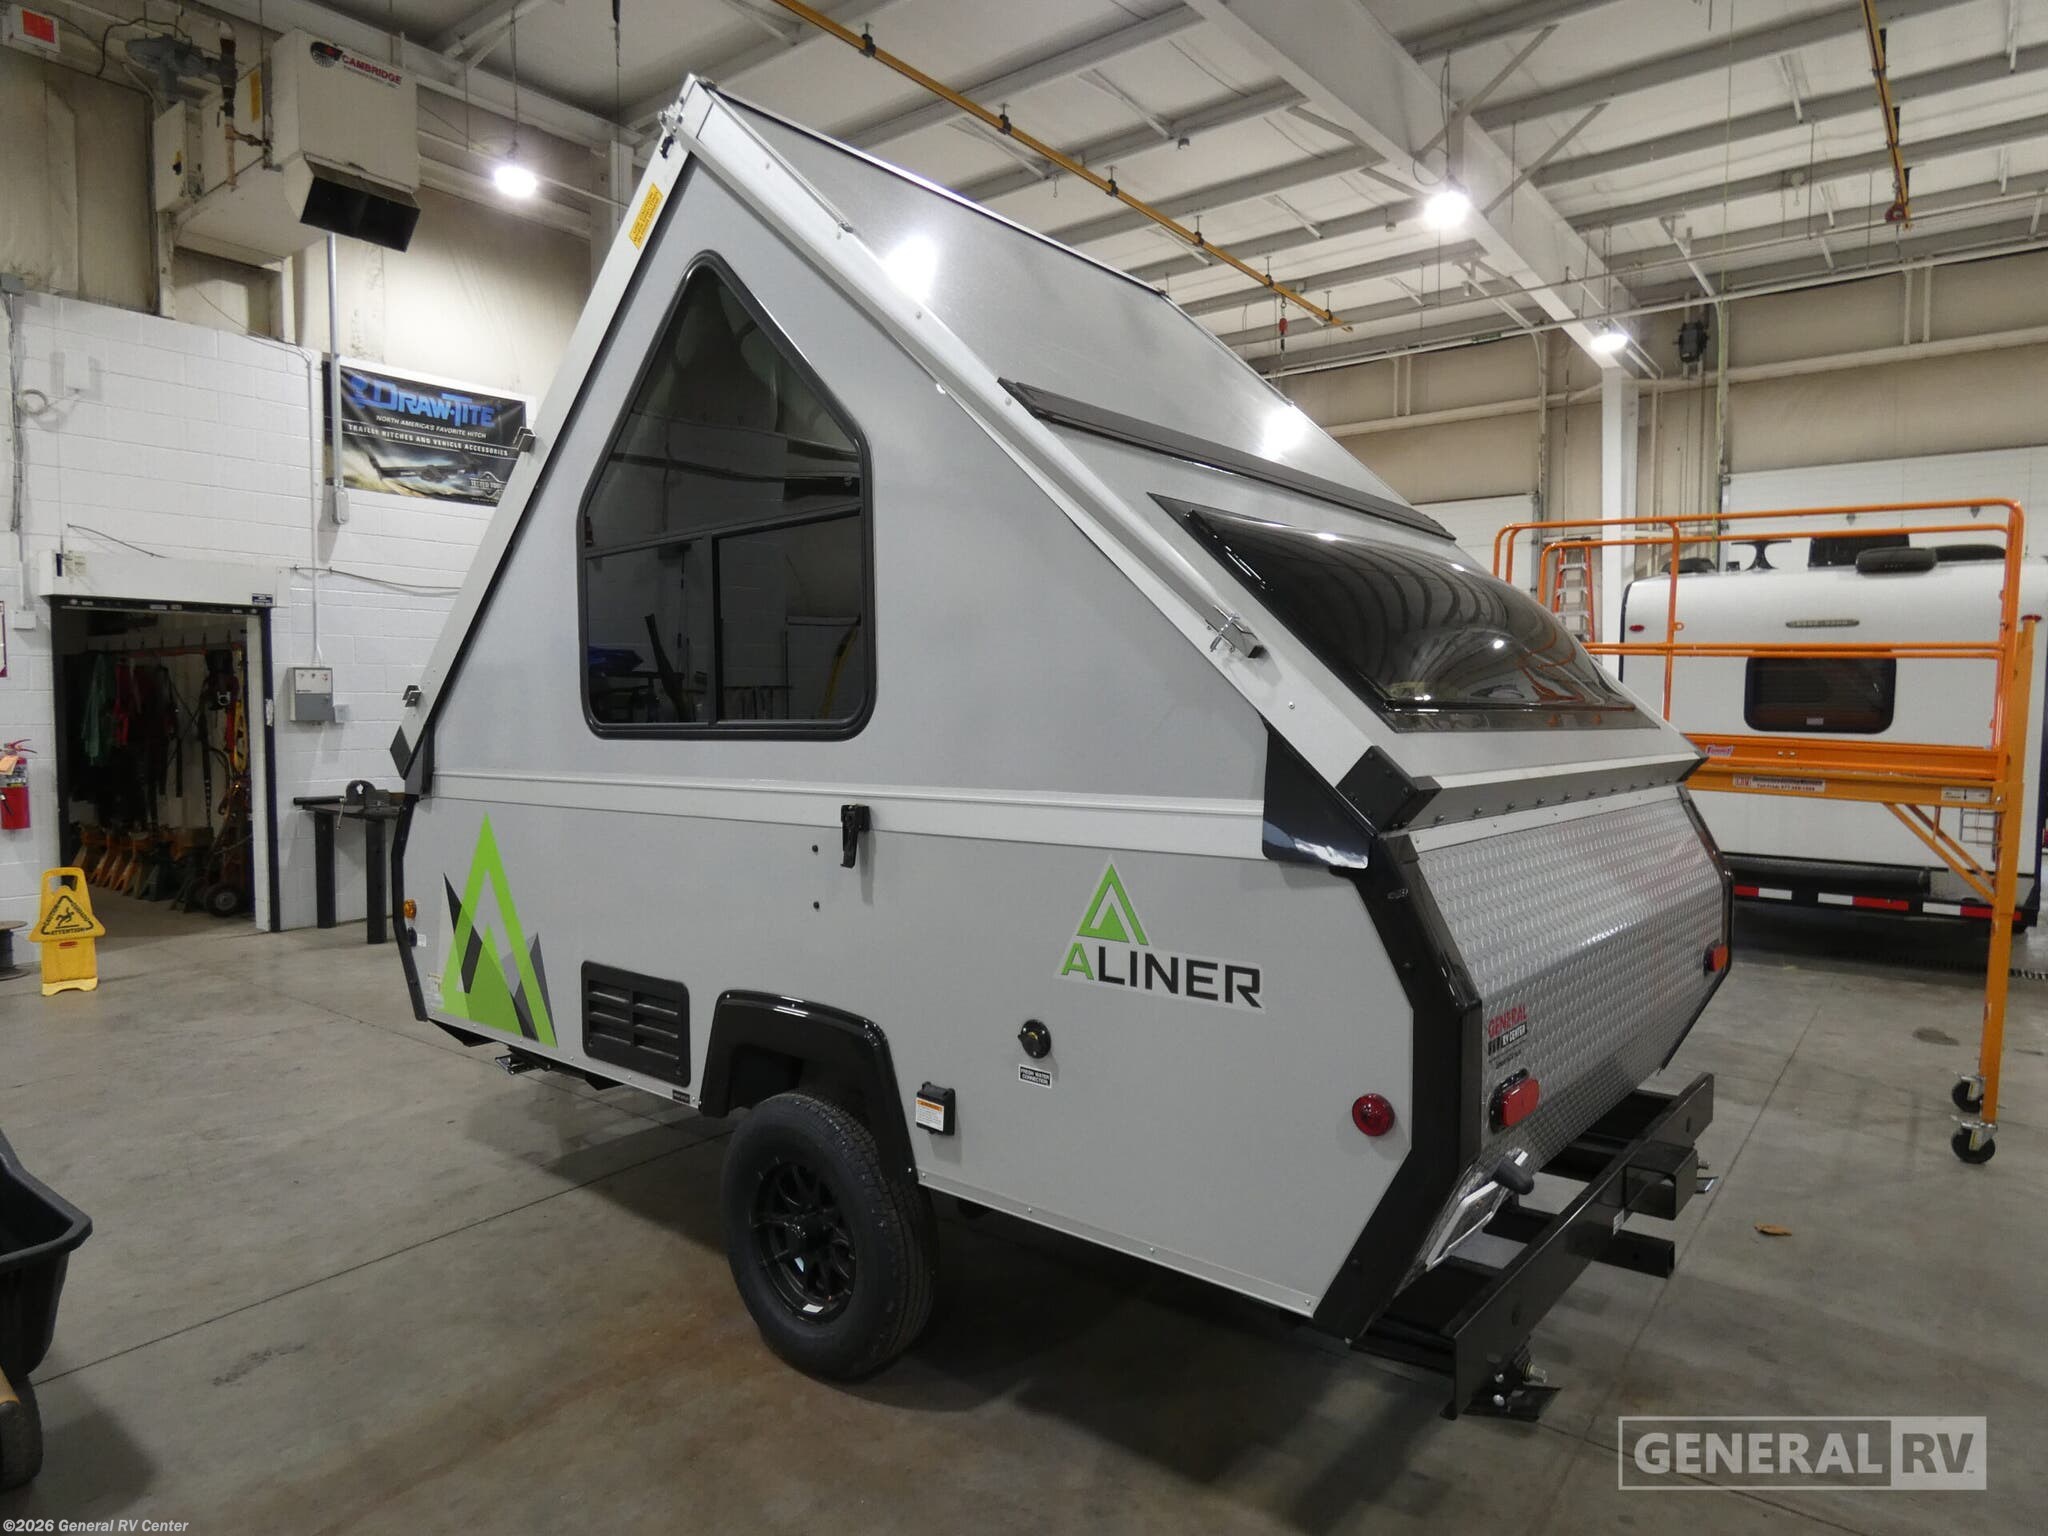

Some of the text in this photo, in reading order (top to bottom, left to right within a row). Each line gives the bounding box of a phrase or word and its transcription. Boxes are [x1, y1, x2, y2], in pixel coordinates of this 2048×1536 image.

[342, 54, 401, 85] CAMBRIDGE
[347, 423, 508, 456] TRAILER HITCHES AND VEHICLE ACCESSORIES
[376, 415, 487, 439] NORTH AMERICA'S FAVORITE HITCH
[1060, 942, 1262, 1008] ALINER
[1488, 1004, 1527, 1039] GENERAL
